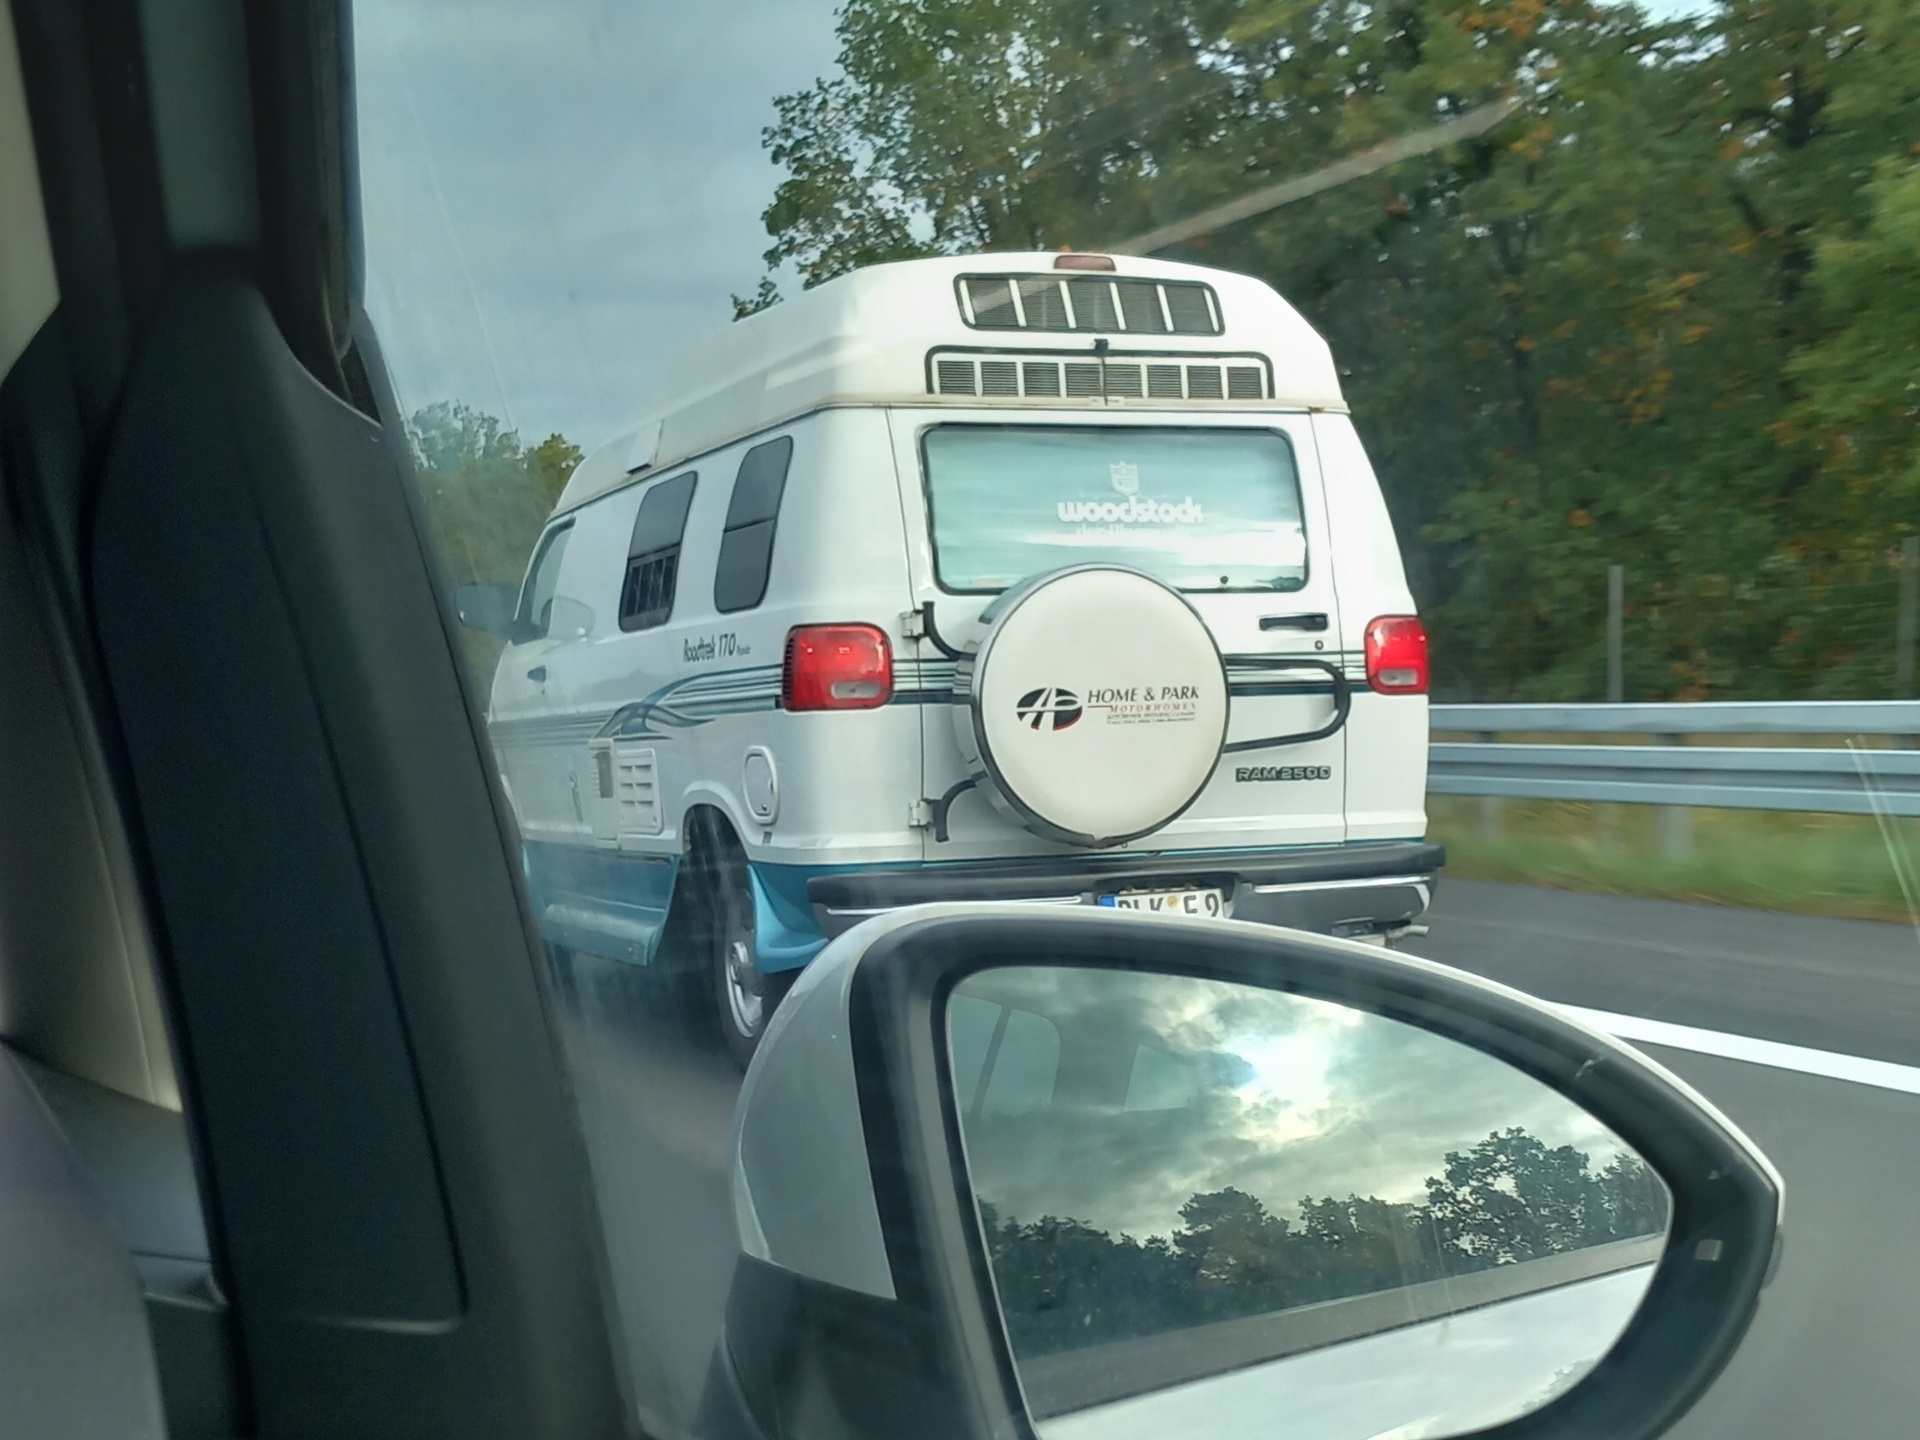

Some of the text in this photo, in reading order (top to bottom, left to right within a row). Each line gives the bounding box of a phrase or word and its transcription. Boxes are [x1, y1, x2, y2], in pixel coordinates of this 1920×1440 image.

[1057, 495, 1205, 523] woodstock
[718, 632, 737, 658] 170
[1087, 685, 1200, 704] HOME & PARK
[1110, 702, 1196, 714] MOTORHOMES
[1235, 766, 1332, 782] RAM 2500
